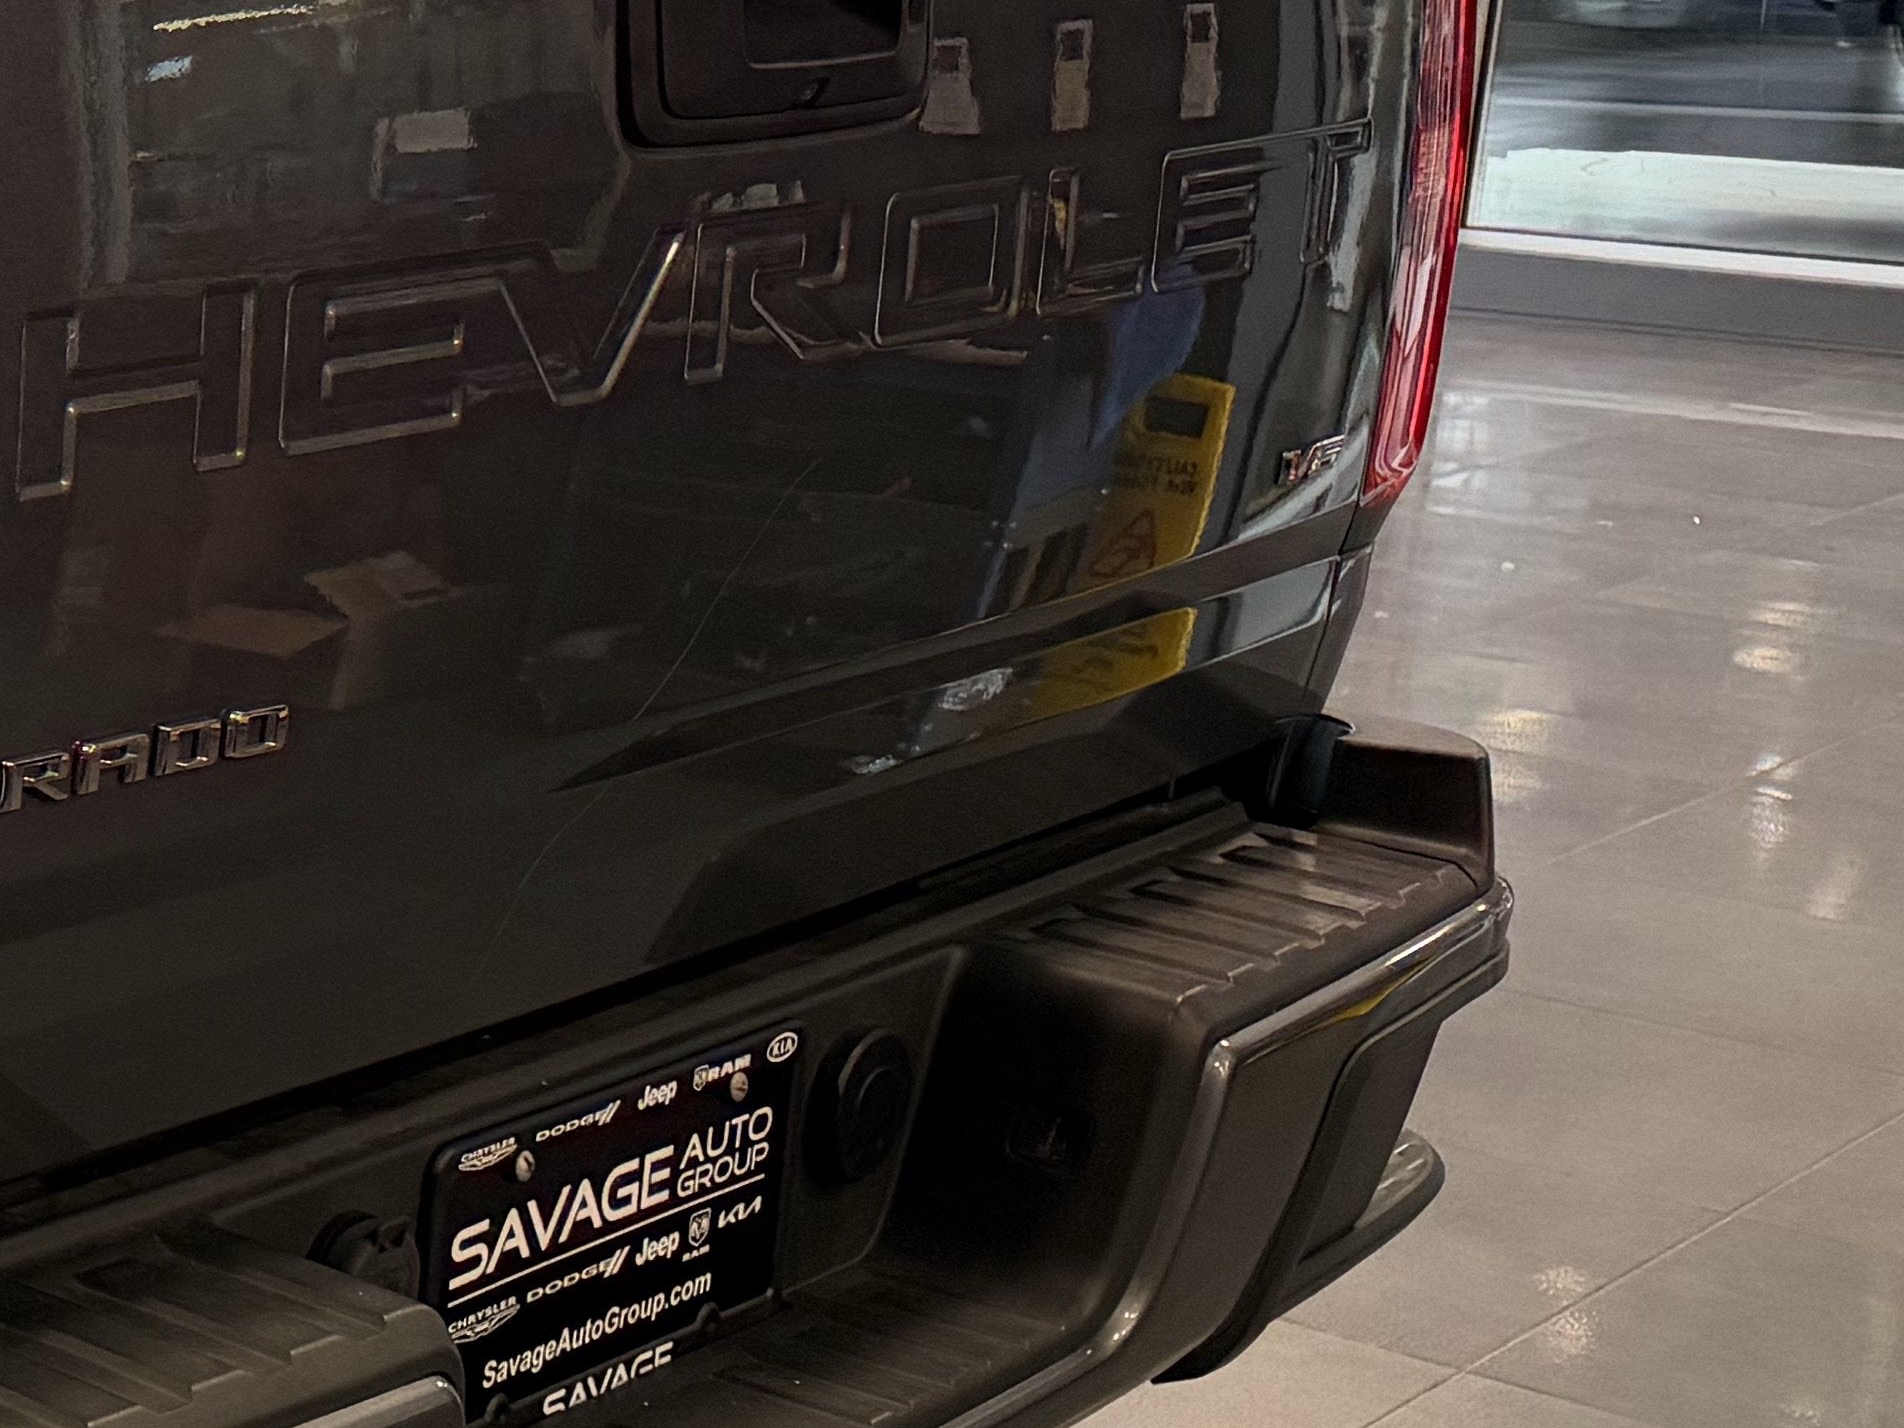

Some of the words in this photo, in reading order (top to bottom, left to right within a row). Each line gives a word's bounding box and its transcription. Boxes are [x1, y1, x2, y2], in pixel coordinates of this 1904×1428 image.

[638, 1081, 678, 1111] Jeep
[771, 1034, 794, 1059] KIA
[677, 1142, 770, 1198] GROUP
[679, 1106, 774, 1169] AUTO
[448, 1145, 675, 1291] SAVAGE
[448, 1296, 517, 1334] CHRYSLER
[527, 1256, 614, 1303] DODGE
[635, 1231, 680, 1266] Jeep
[482, 1272, 712, 1389] SavageAutoGroup.com
[542, 1341, 674, 1415] SAVAGE
